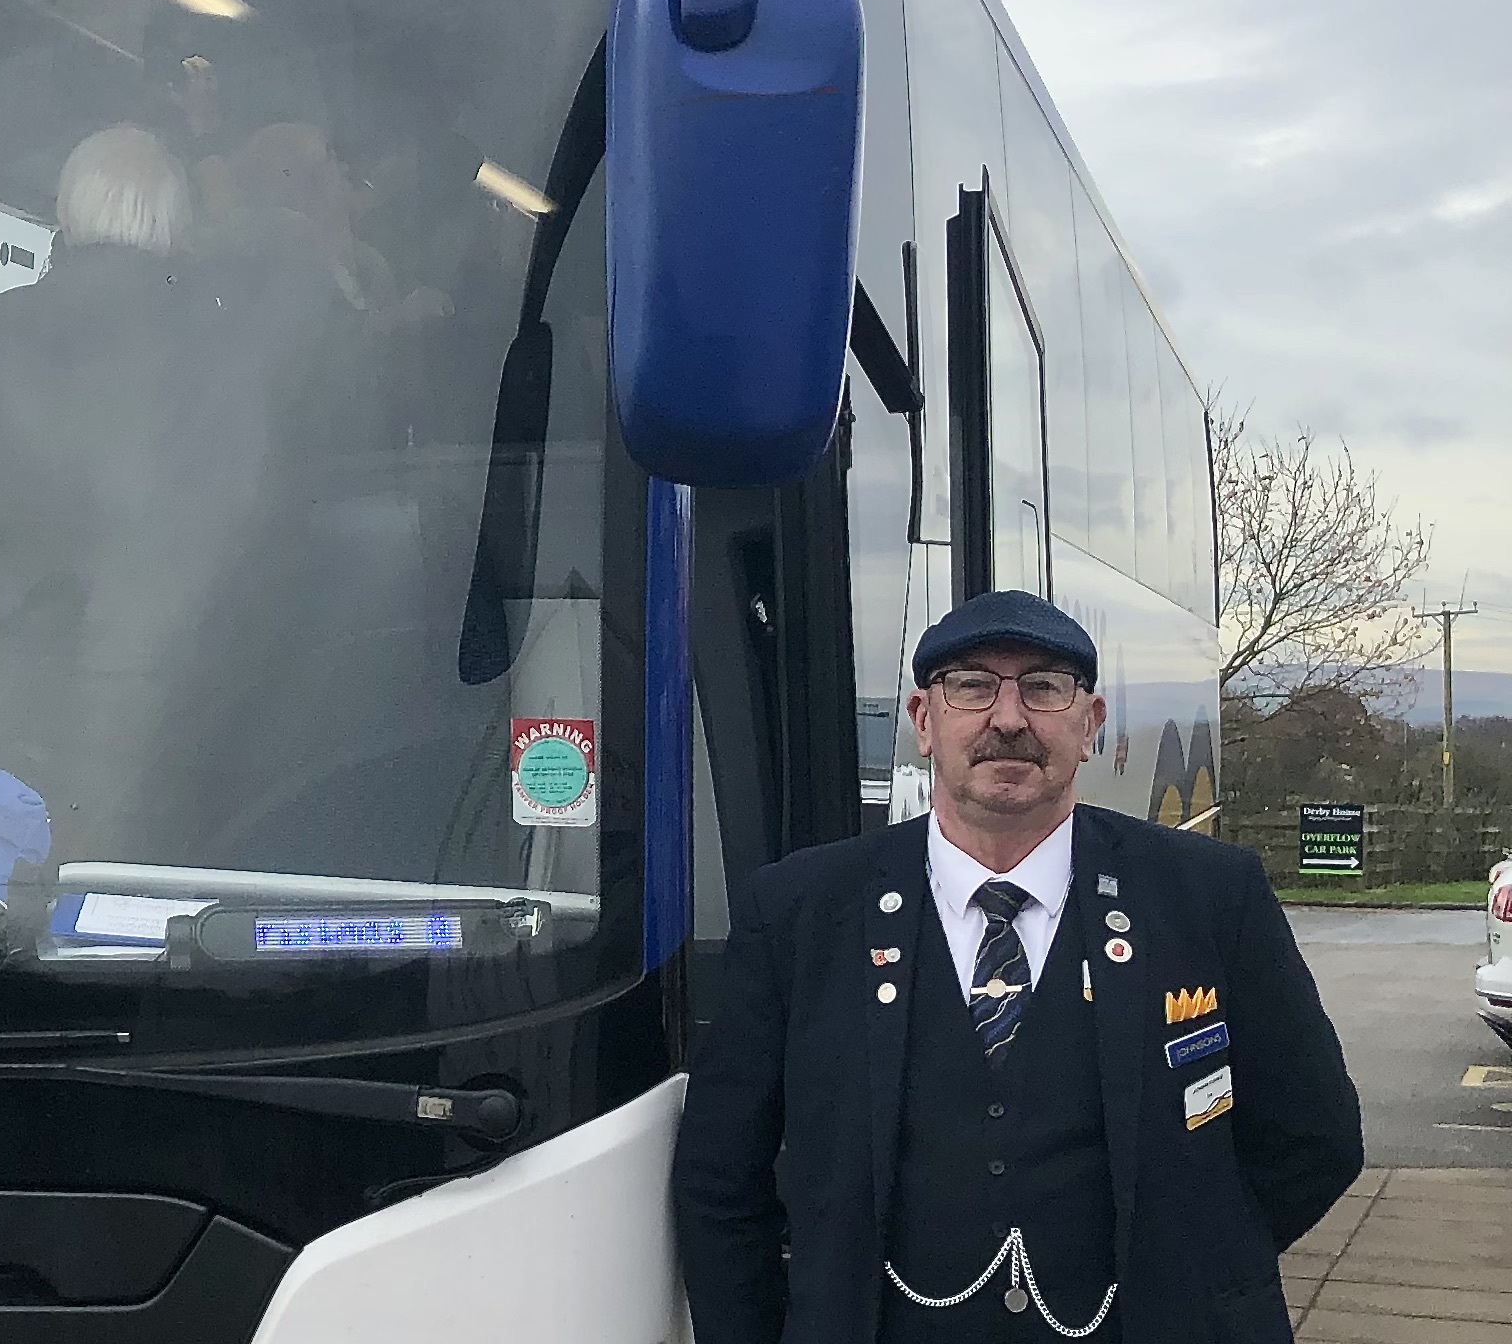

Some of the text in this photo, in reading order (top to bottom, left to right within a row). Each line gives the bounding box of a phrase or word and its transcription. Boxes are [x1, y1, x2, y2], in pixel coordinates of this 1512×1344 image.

[514, 722, 593, 754] WARNING
[540, 807, 568, 815] PROOF
[1303, 806, 1330, 817] Derby
[1301, 833, 1361, 842] OVERFLOW
[1304, 845, 1357, 854] CAR PARK
